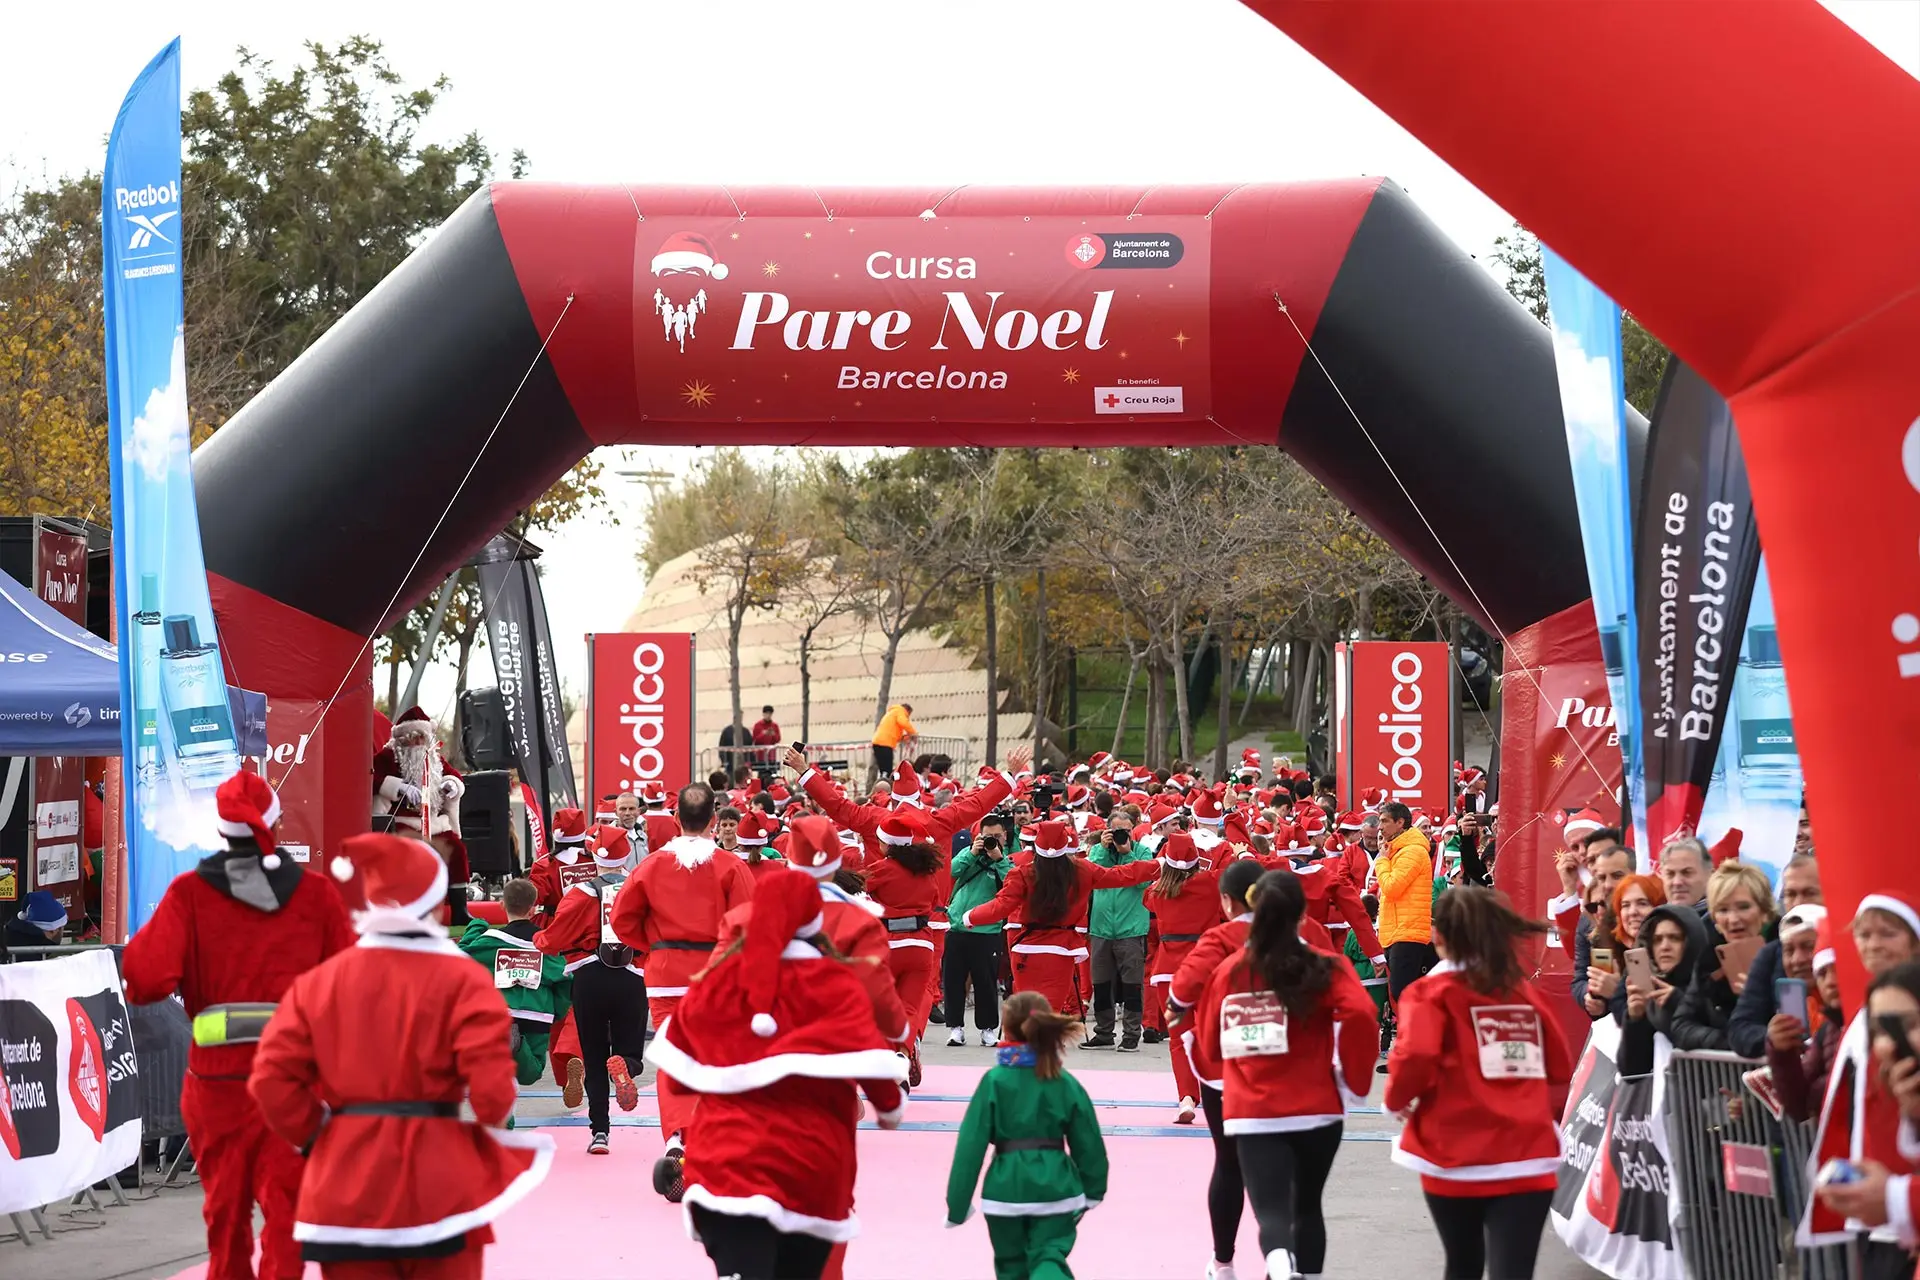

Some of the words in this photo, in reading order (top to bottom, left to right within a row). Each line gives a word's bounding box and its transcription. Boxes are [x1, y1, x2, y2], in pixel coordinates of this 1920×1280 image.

[1112, 249, 1170, 258] Barcelona
[1113, 240, 1158, 249] Ajuntament
[865, 250, 978, 280] Cursa
[728, 290, 912, 351] Pare
[929, 289, 1115, 351] Noel
[837, 364, 1008, 390] Barcelona
[1129, 377, 1160, 385] benefici
[1124, 396, 1149, 404] Creu
[1152, 396, 1175, 405] Roja
[44, 570, 62, 601] Pare
[1679, 500, 1735, 741] Barcelona
[0, 711, 38, 721] owered
[41, 711, 54, 721] by
[507, 969, 531, 978] 1597
[1241, 1025, 1265, 1041] 321
[30, 1035, 41, 1062] de
[1502, 1042, 1526, 1060] 323
[5, 1074, 47, 1111] rcelona
